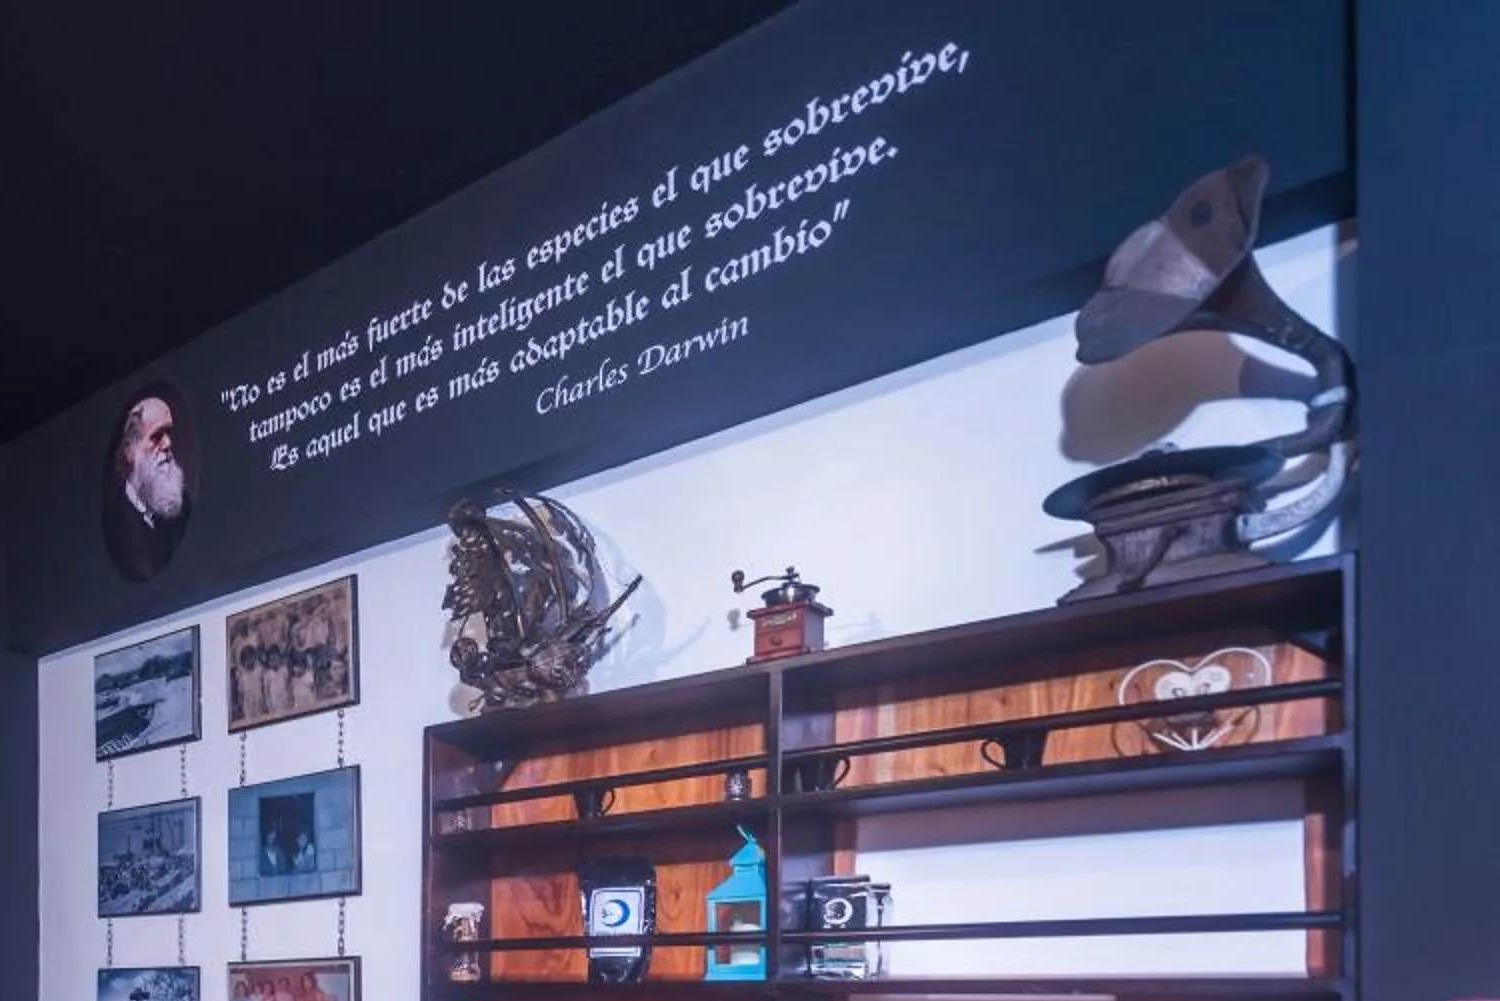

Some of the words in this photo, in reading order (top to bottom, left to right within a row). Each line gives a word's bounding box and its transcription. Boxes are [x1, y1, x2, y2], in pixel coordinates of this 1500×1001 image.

[250, 391, 332, 442] tampoco
[339, 377, 362, 402] es
[369, 355, 389, 388] el
[396, 335, 443, 377] más
[452, 271, 590, 351] inteligente
[601, 243, 626, 284] el
[636, 224, 692, 271] que
[705, 136, 899, 239] sobrevive.
[267, 371, 286, 395] es
[293, 350, 310, 382] el
[316, 331, 359, 372] más
[367, 298, 432, 352] fuerte
[441, 281, 469, 310] de
[478, 260, 516, 293] las
[527, 196, 639, 270] especies
[652, 165, 679, 208] el
[690, 144, 749, 194] que
[763, 41, 970, 156] sobrevive,
[269, 443, 300, 471] Es
[305, 410, 362, 459] aquel
[368, 399, 407, 437] que
[415, 386, 439, 413] es
[449, 357, 500, 401] más
[508, 289, 650, 374] adaptable
[661, 264, 694, 310] al
[536, 357, 629, 415] Charles
[637, 316, 749, 376] Darwin
